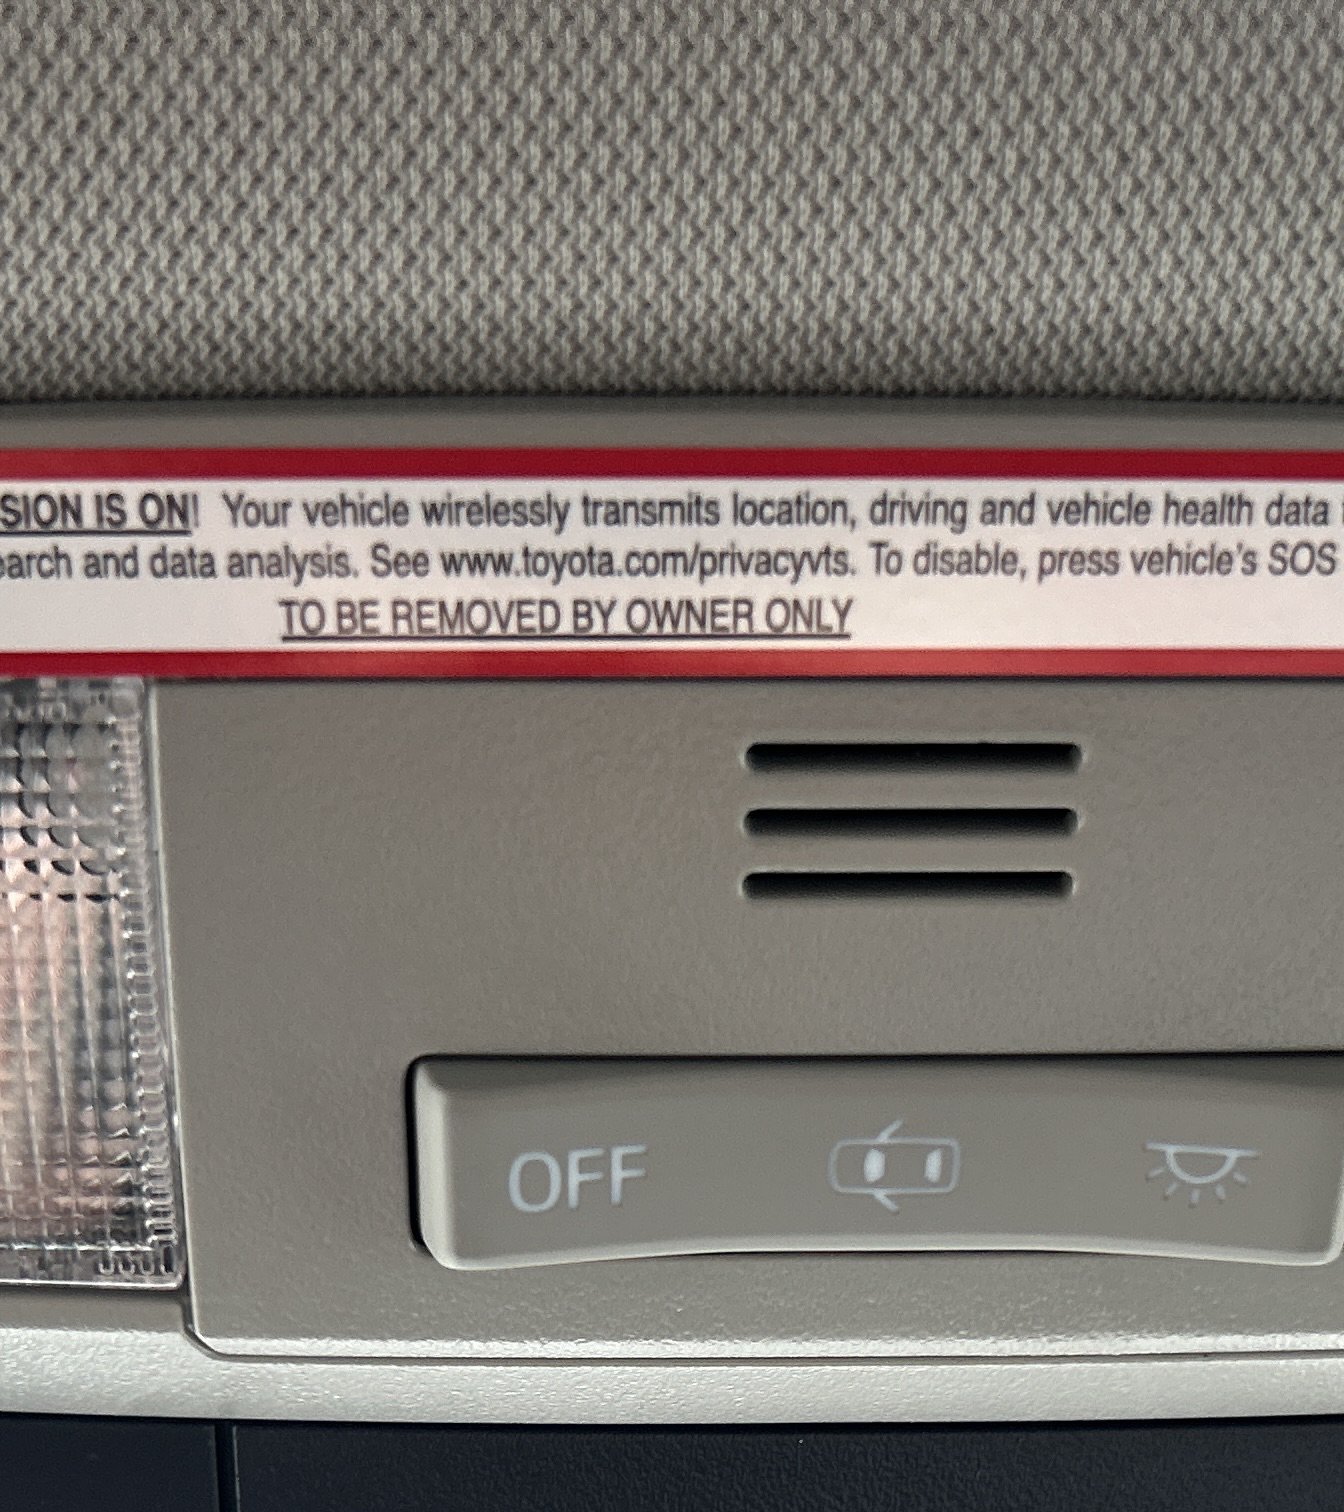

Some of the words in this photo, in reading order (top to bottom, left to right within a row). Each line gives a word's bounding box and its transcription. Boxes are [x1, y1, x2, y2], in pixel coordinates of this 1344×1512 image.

[94, 492, 127, 529] IS
[140, 491, 199, 528] ON!
[221, 490, 293, 528] Your
[302, 491, 410, 528] vehicle
[420, 491, 571, 536] wirelessly
[581, 491, 721, 527] transmits
[732, 490, 857, 530] location,
[868, 489, 968, 535] driving
[979, 491, 1037, 526] and
[1046, 491, 1153, 526] vehicle
[1163, 492, 1255, 526] health
[1264, 493, 1330, 527] data
[83, 544, 140, 580] and
[149, 544, 218, 579] data
[226, 543, 359, 583] analysis.
[370, 541, 430, 578] See
[439, 542, 856, 583] www.toyota.com/privacyvts.
[868, 539, 903, 576] To
[912, 540, 1027, 580] disable,
[1037, 548, 1121, 583] press
[1129, 542, 1258, 577] vehicle's
[1267, 539, 1338, 576] SOS
[277, 598, 326, 635] TO
[335, 598, 381, 635] BE
[391, 598, 561, 635] REMOVED
[572, 598, 617, 635] BY
[625, 597, 755, 635] OWNER
[762, 596, 854, 635] ONLY
[508, 1145, 646, 1213] OFF
